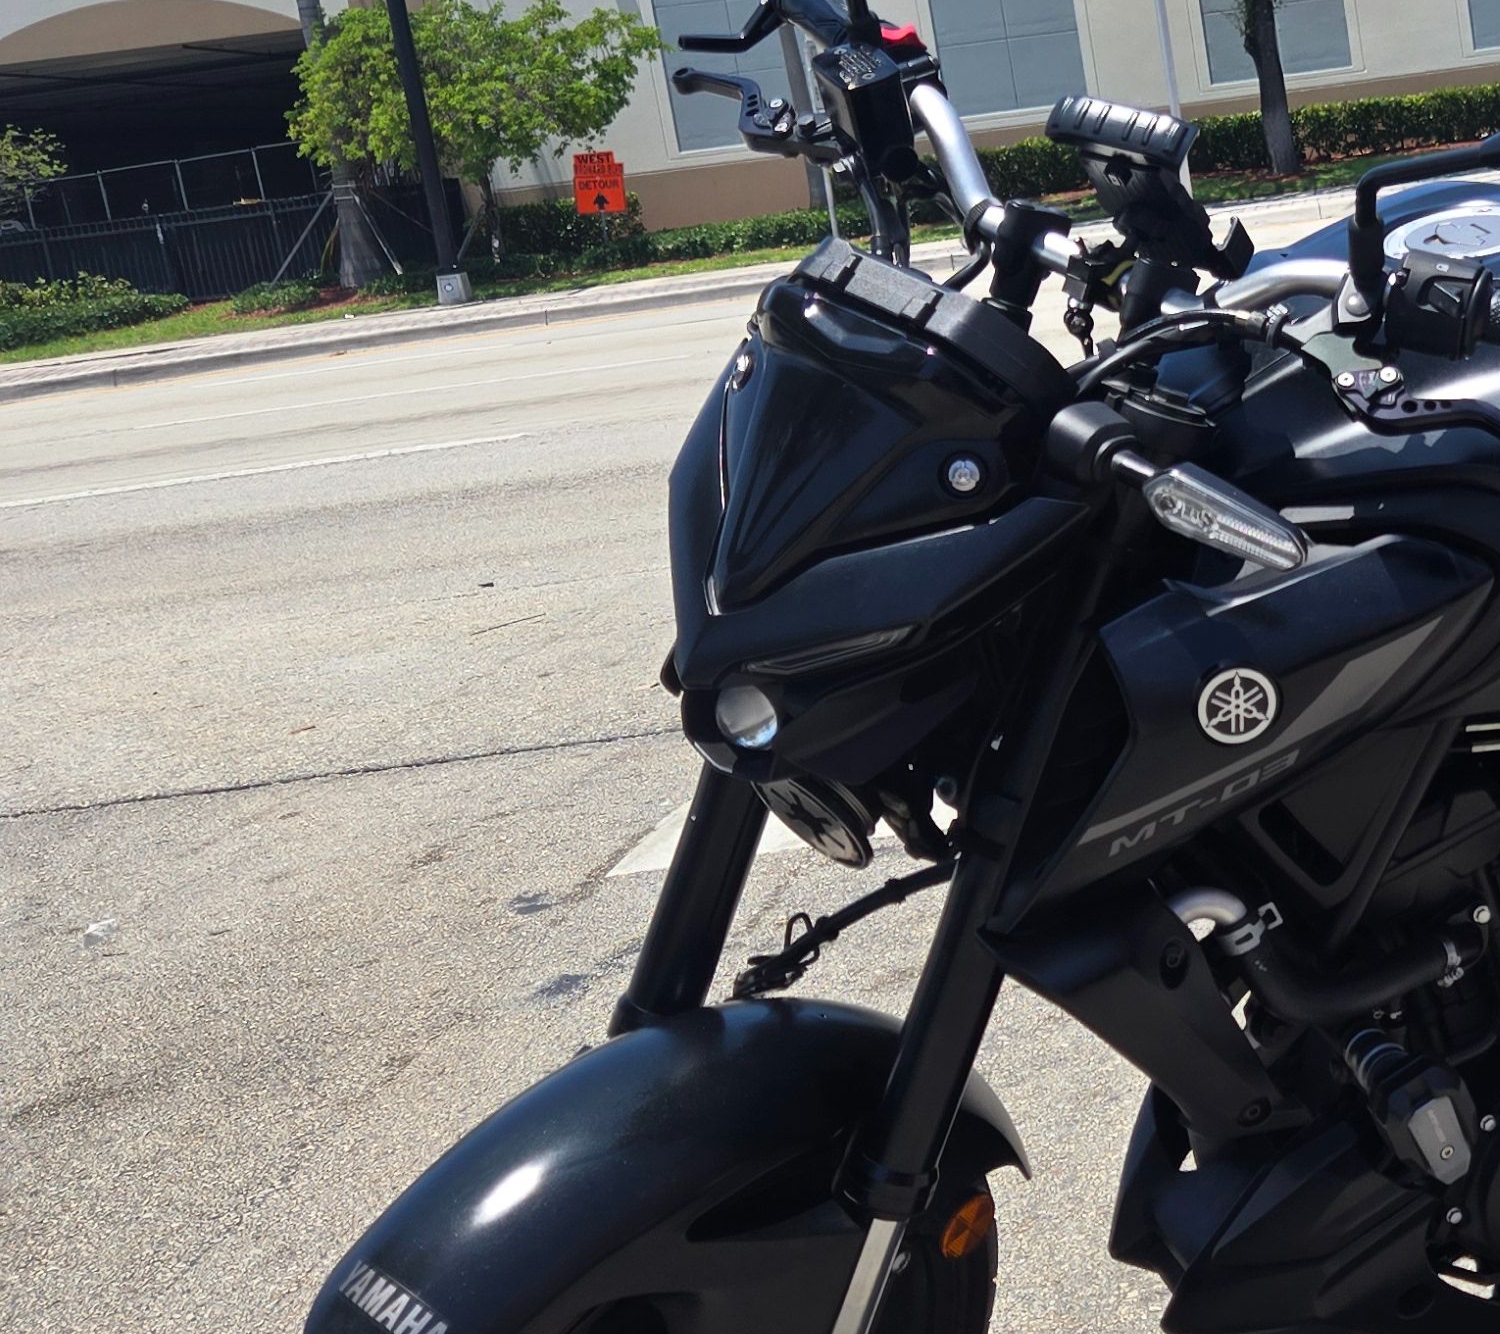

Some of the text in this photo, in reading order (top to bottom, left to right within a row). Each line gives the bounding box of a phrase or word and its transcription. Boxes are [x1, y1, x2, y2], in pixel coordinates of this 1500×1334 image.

[577, 153, 611, 165] WEST
[578, 179, 619, 191] DETOUR
[1108, 749, 1300, 857] MT-03
